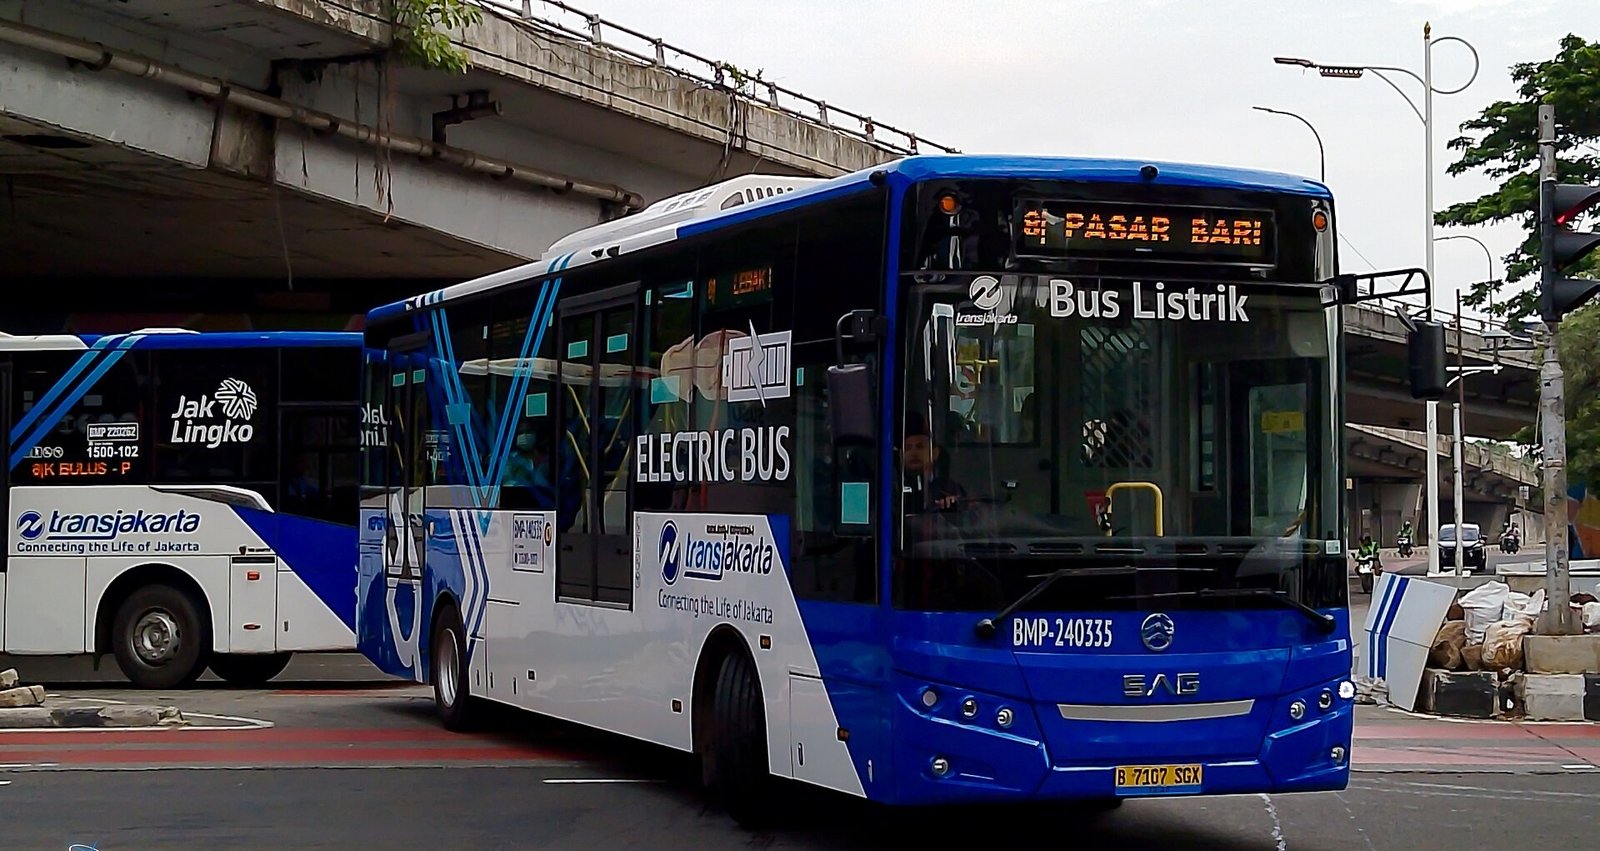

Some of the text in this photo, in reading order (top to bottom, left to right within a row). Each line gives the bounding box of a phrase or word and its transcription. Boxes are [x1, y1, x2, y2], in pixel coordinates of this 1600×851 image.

[1065, 212, 1170, 242] PASAR
[1050, 279, 1250, 322] Bus Listrik
[171, 394, 216, 418] Jak
[171, 419, 253, 449] Lingko
[86, 445, 139, 458] 1500-102
[636, 425, 790, 483] ELECTRIC BUS
[46, 509, 201, 540] transjakarta
[17, 541, 200, 554] Connecting the Life of Jakarta
[684, 532, 773, 581] transjakarta
[658, 588, 773, 624] Connecting the Life of Jakarta
[1013, 618, 1113, 647] BMP-240335
[1122, 672, 1200, 696] SAG
[1118, 766, 1200, 786] B 7107 SGX
